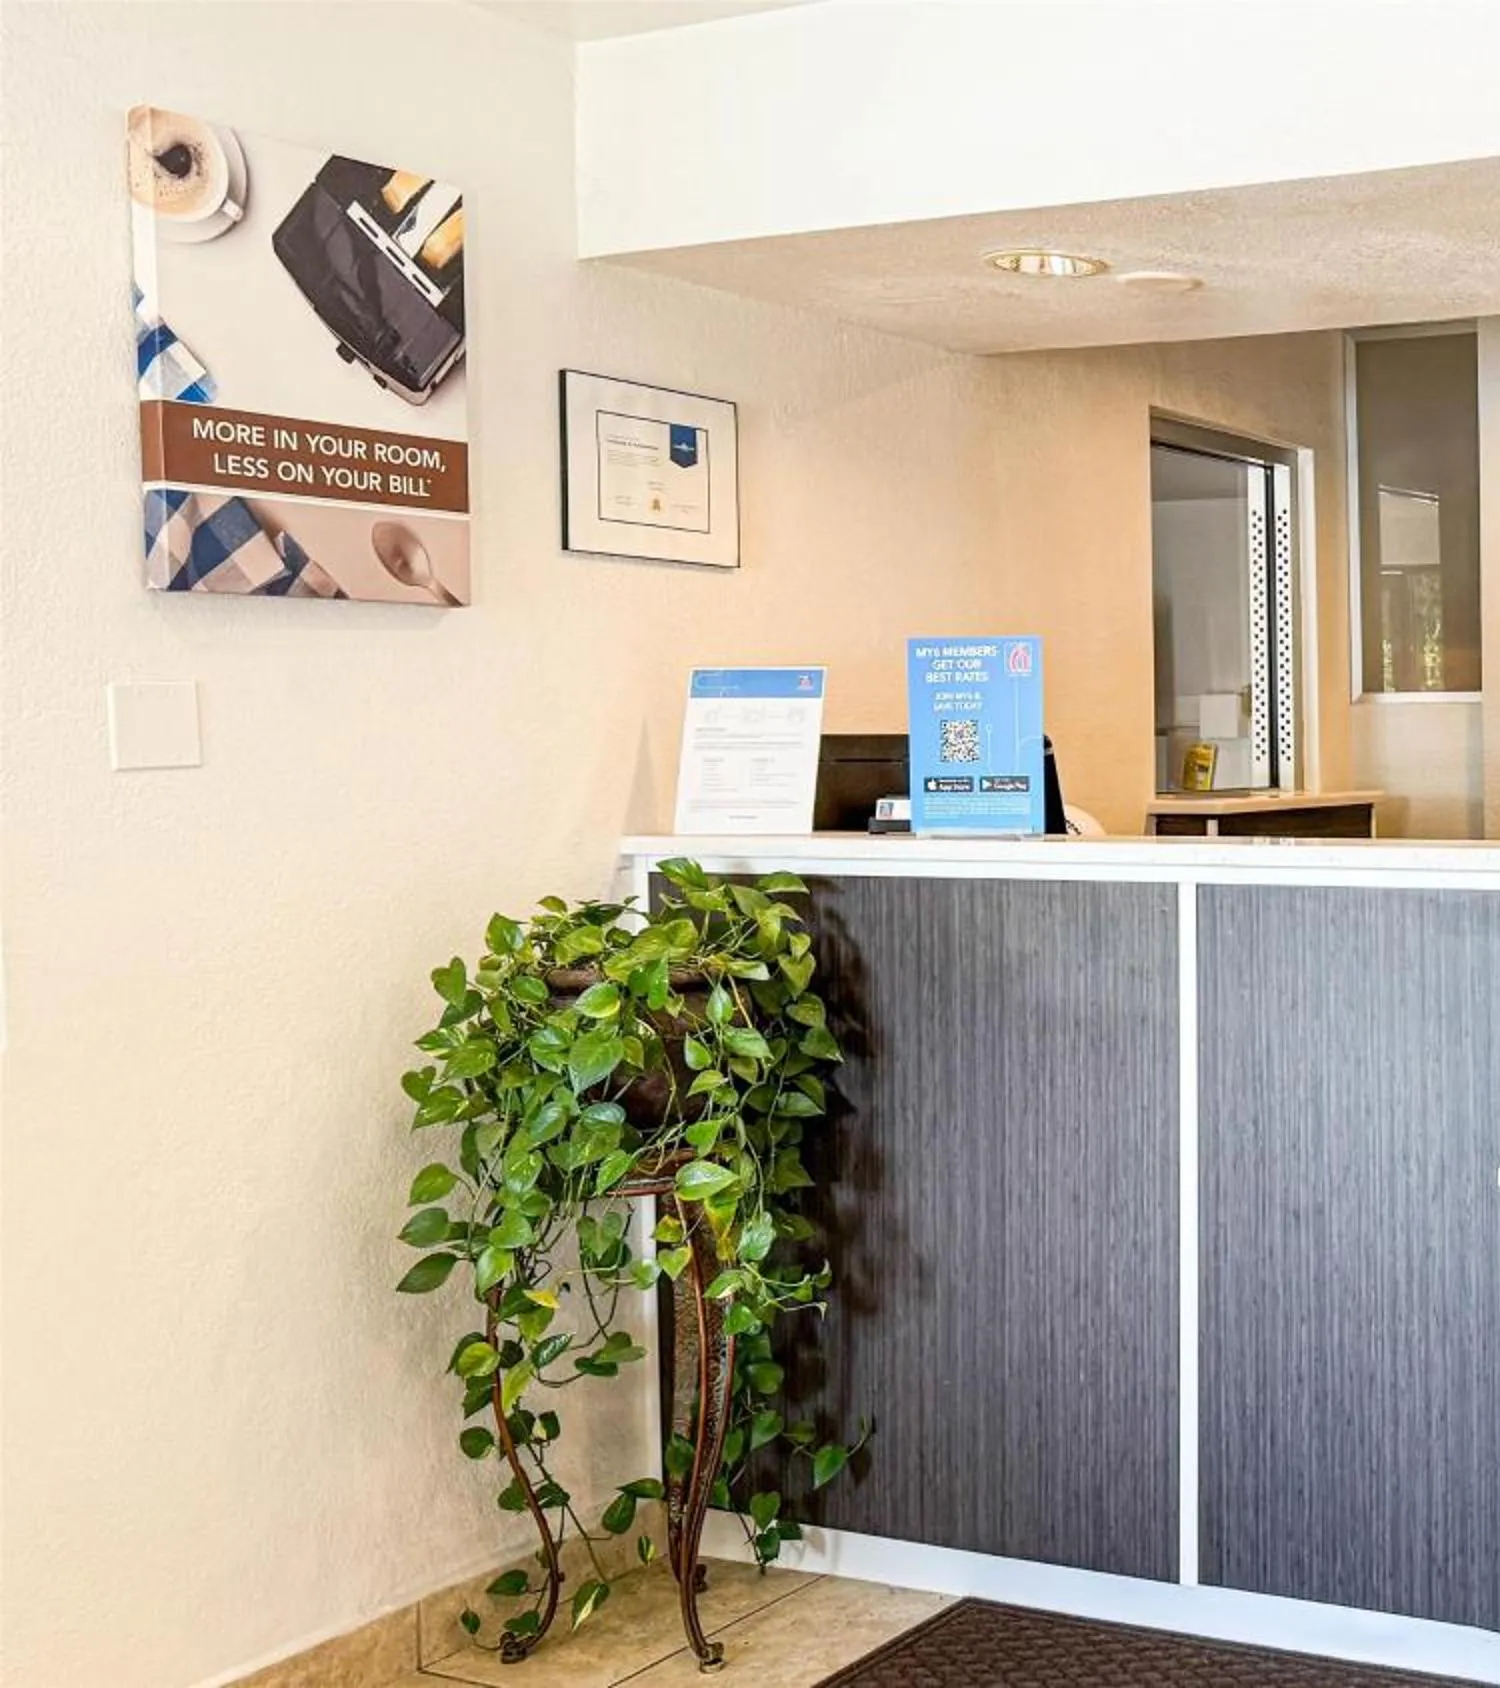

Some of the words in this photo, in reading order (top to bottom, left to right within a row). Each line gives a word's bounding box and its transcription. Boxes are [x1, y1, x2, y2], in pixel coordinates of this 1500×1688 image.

[192, 417, 266, 448] MORE
[273, 428, 299, 451] IN
[305, 433, 368, 460] YOUR
[374, 437, 448, 473] ROOM,
[213, 453, 270, 479] LESS
[276, 461, 315, 485] ON
[319, 466, 382, 492] YOUR
[942, 645, 998, 657] MEMBERS
[931, 659, 954, 671] GET
[957, 659, 982, 670] OUR
[925, 671, 953, 684] BEST
[955, 671, 990, 683] RATES
